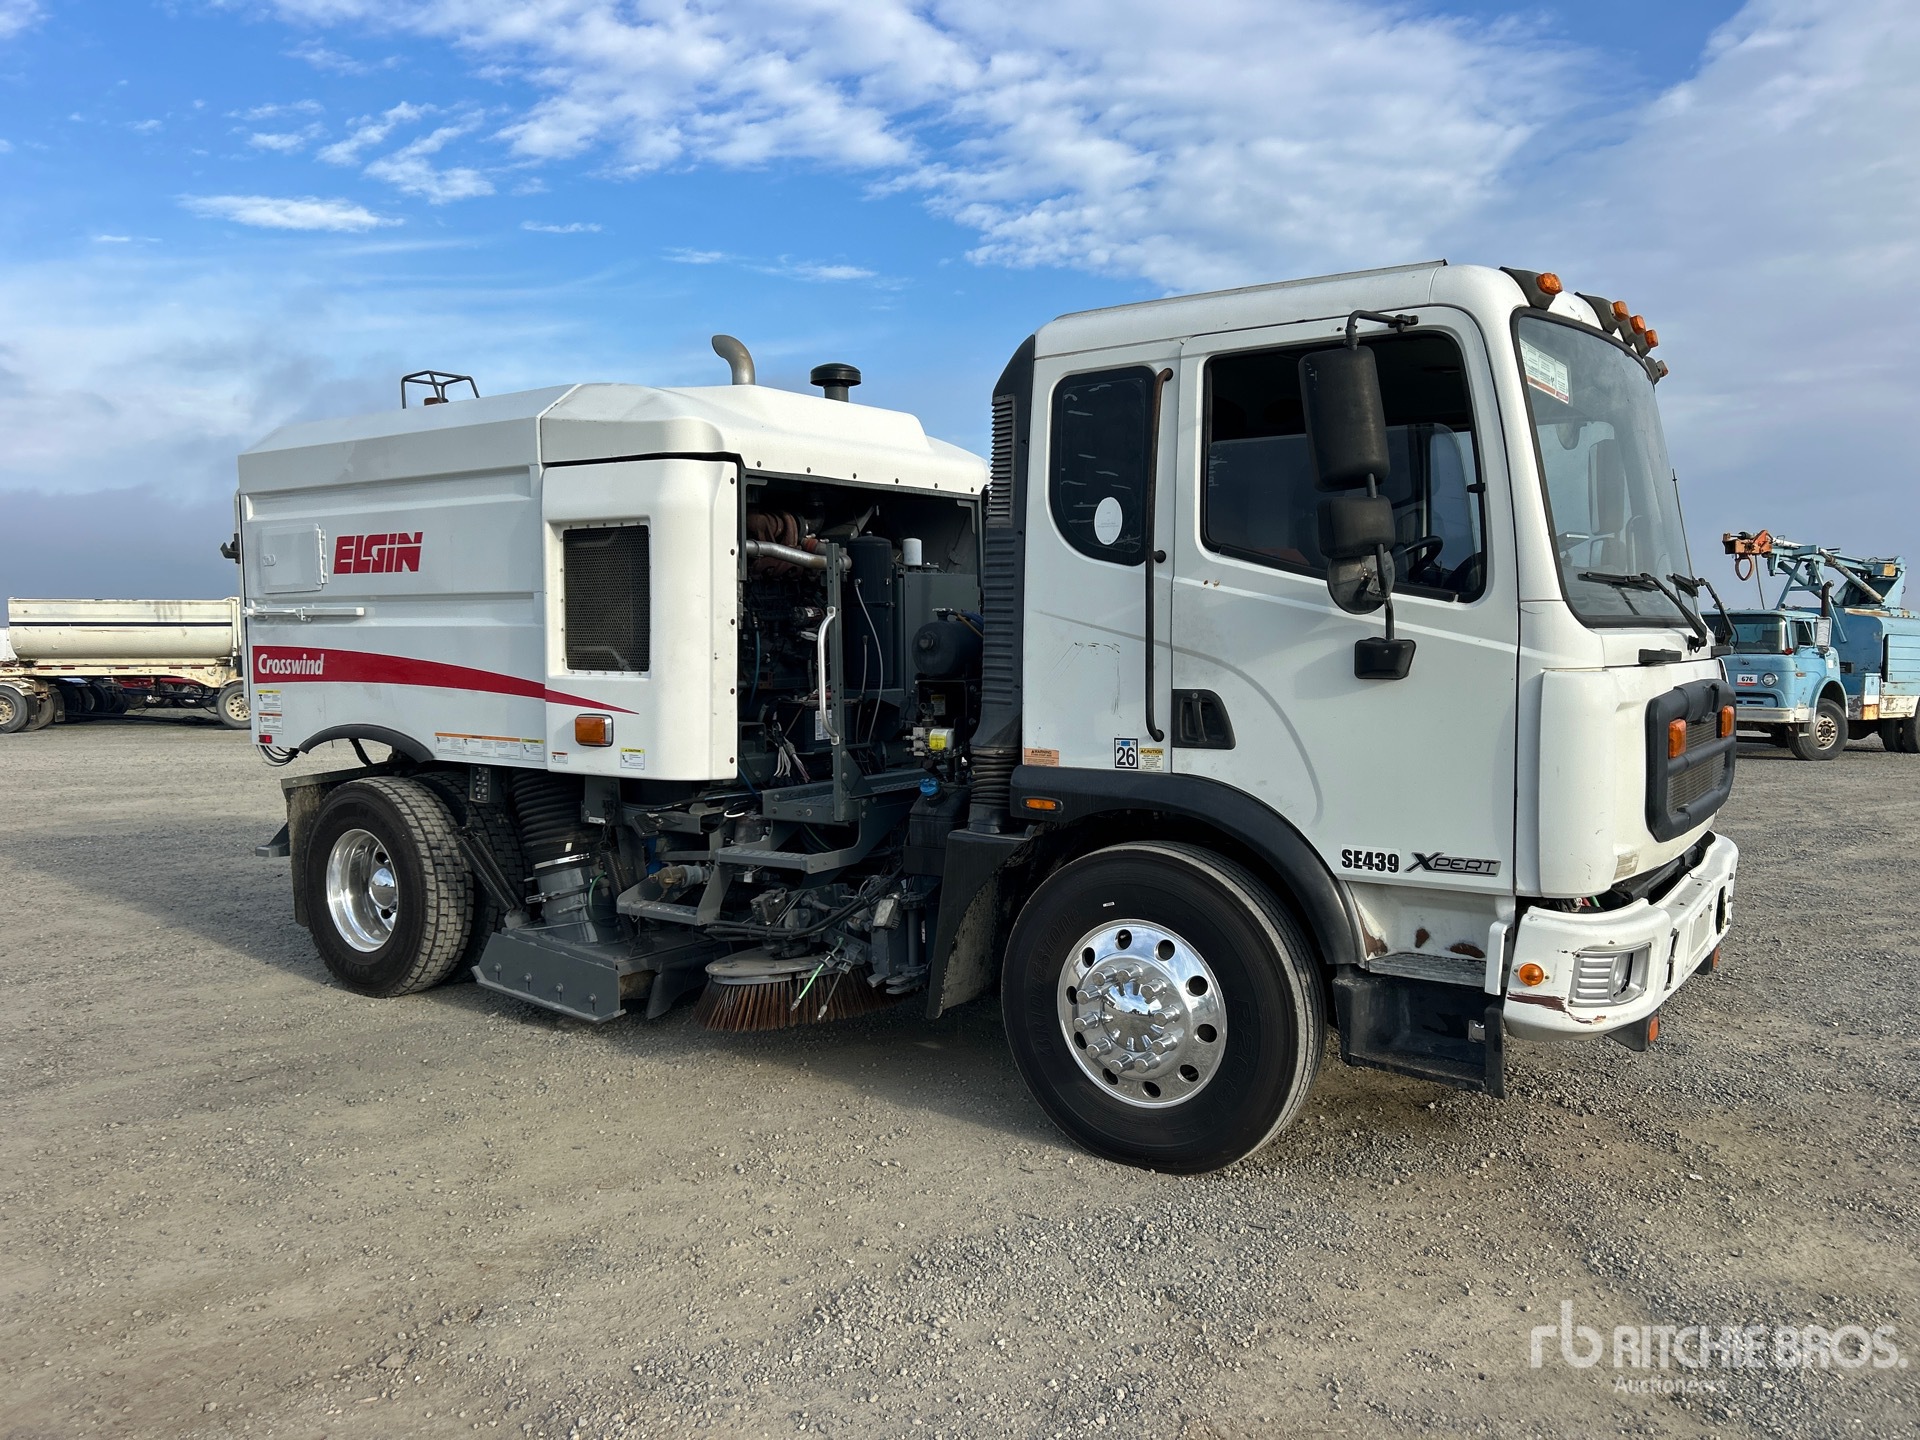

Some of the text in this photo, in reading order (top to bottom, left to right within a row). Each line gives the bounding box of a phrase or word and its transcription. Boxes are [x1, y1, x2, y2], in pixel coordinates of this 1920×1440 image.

[333, 531, 424, 575] ELGIN
[258, 653, 325, 675] Crosswind
[1116, 746, 1136, 766] 26
[1341, 848, 1499, 876] SE439 XPERT
